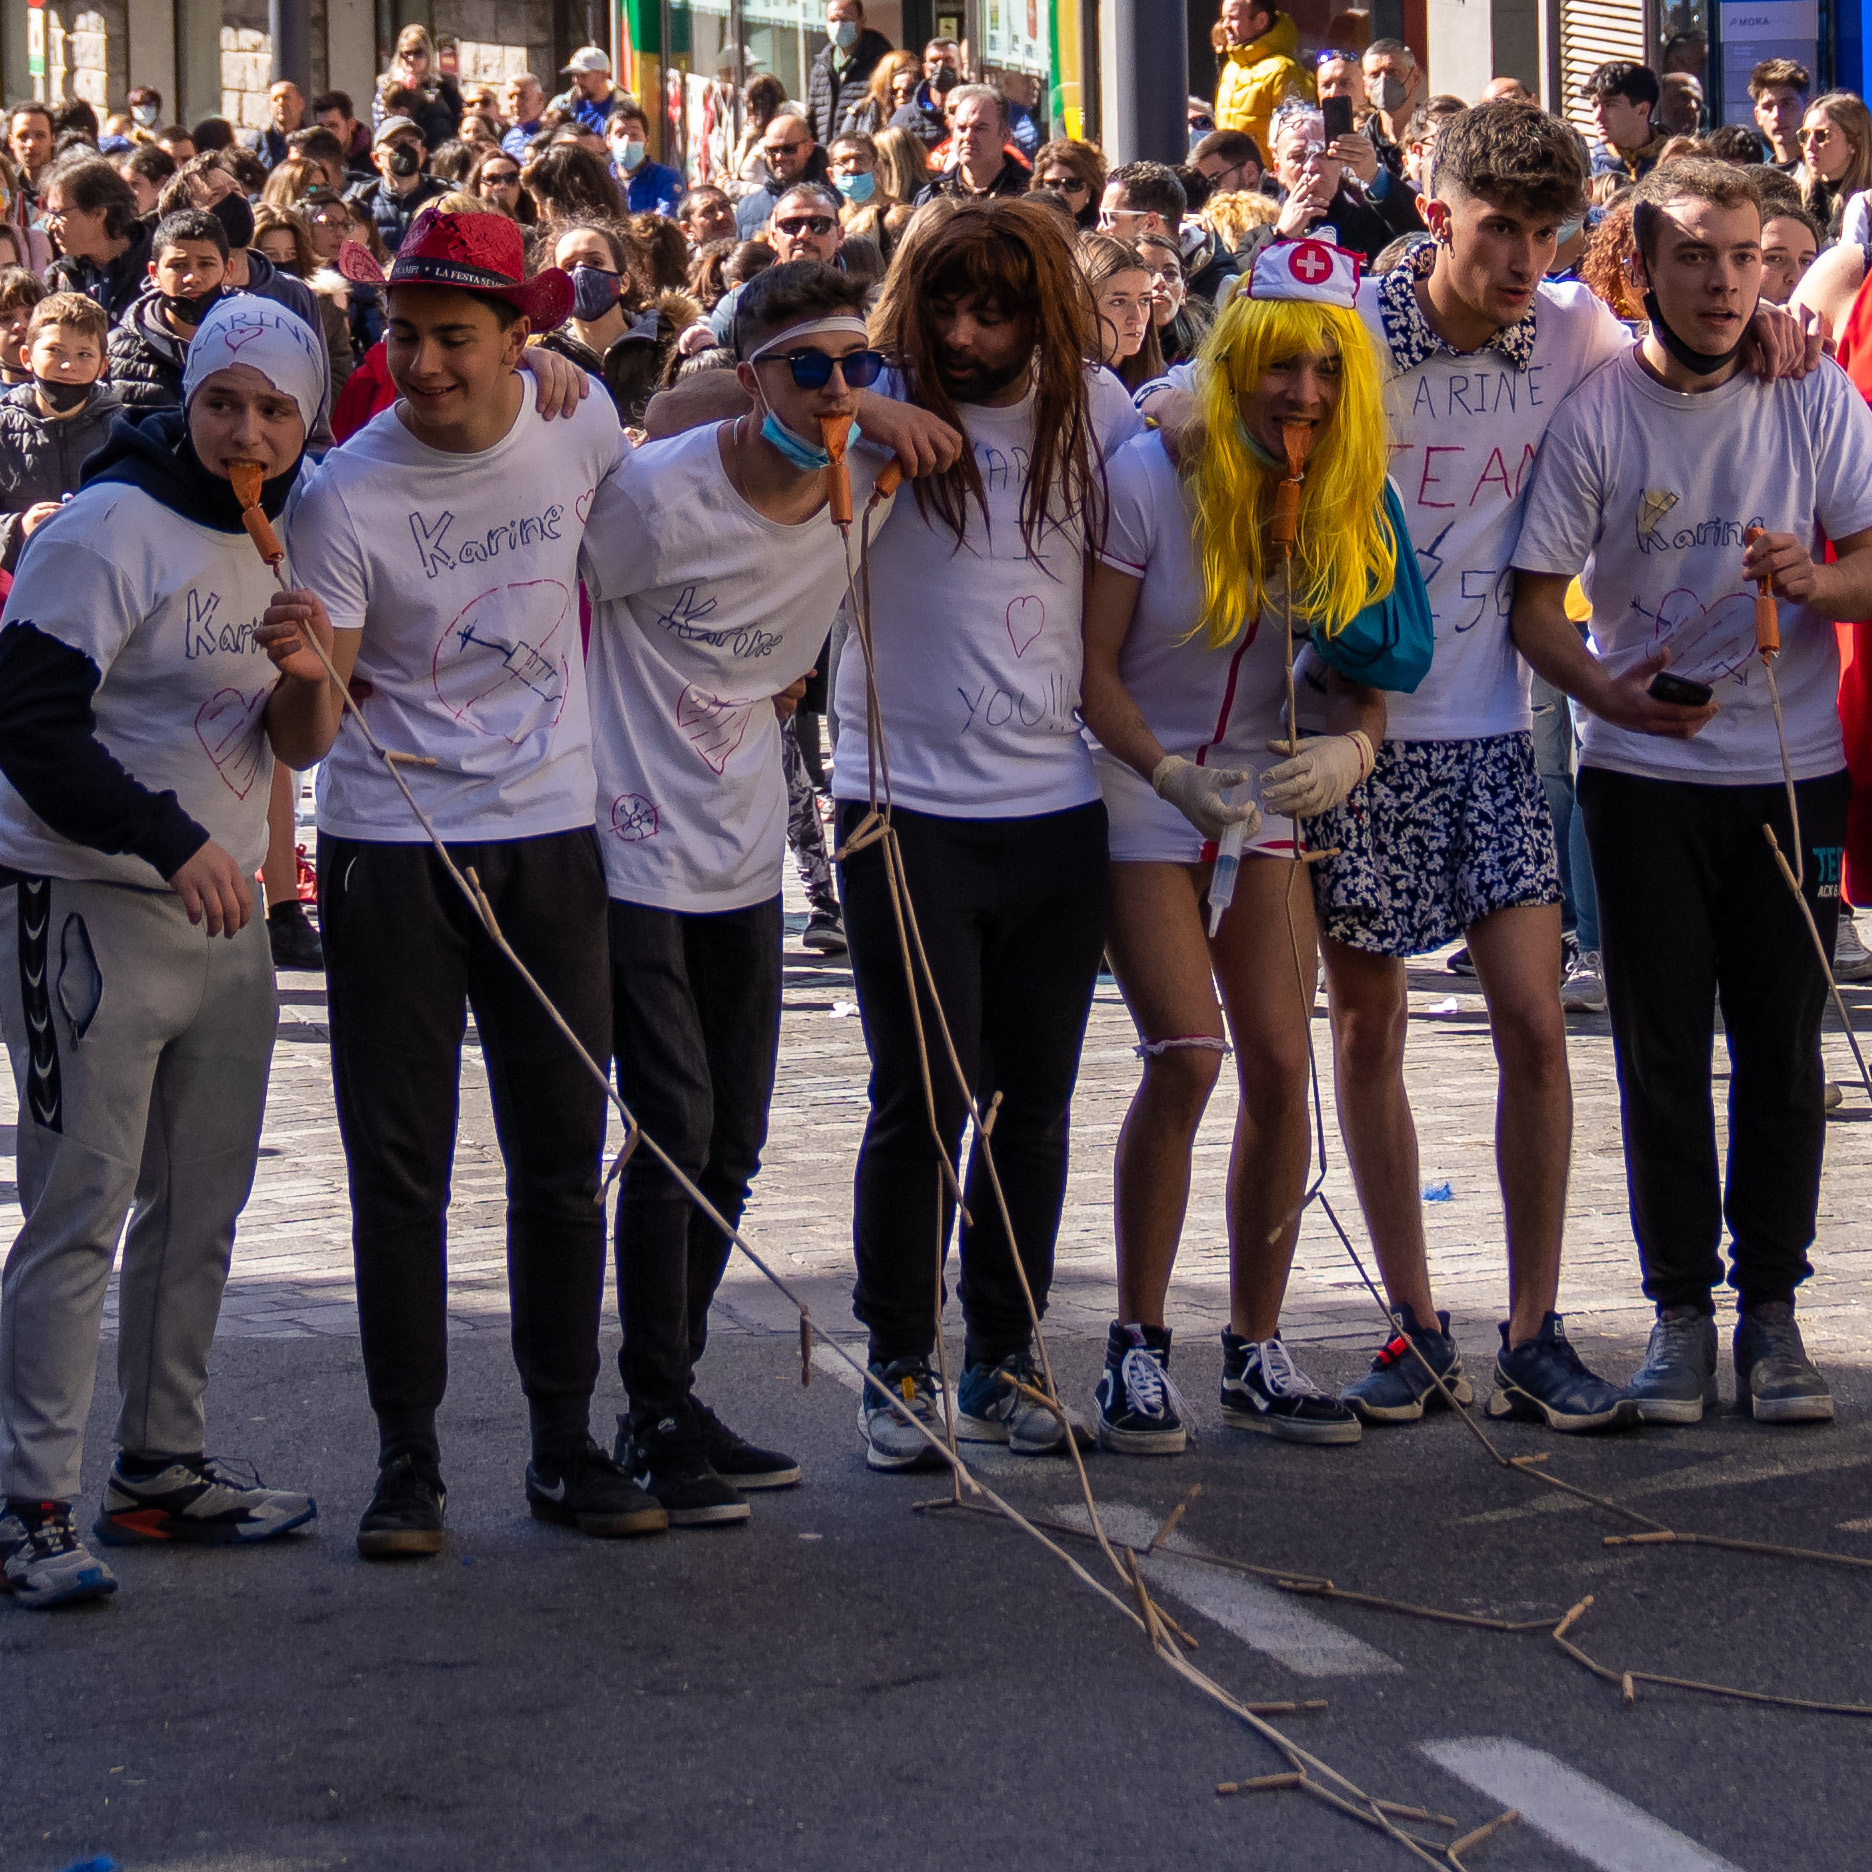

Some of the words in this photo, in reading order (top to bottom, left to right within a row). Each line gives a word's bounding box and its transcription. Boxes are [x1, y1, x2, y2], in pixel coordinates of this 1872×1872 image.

[435, 267, 449, 278] LA
[449, 270, 481, 286] FESTA
[1410, 363, 1544, 419] ARINE
[409, 504, 564, 578] Karine
